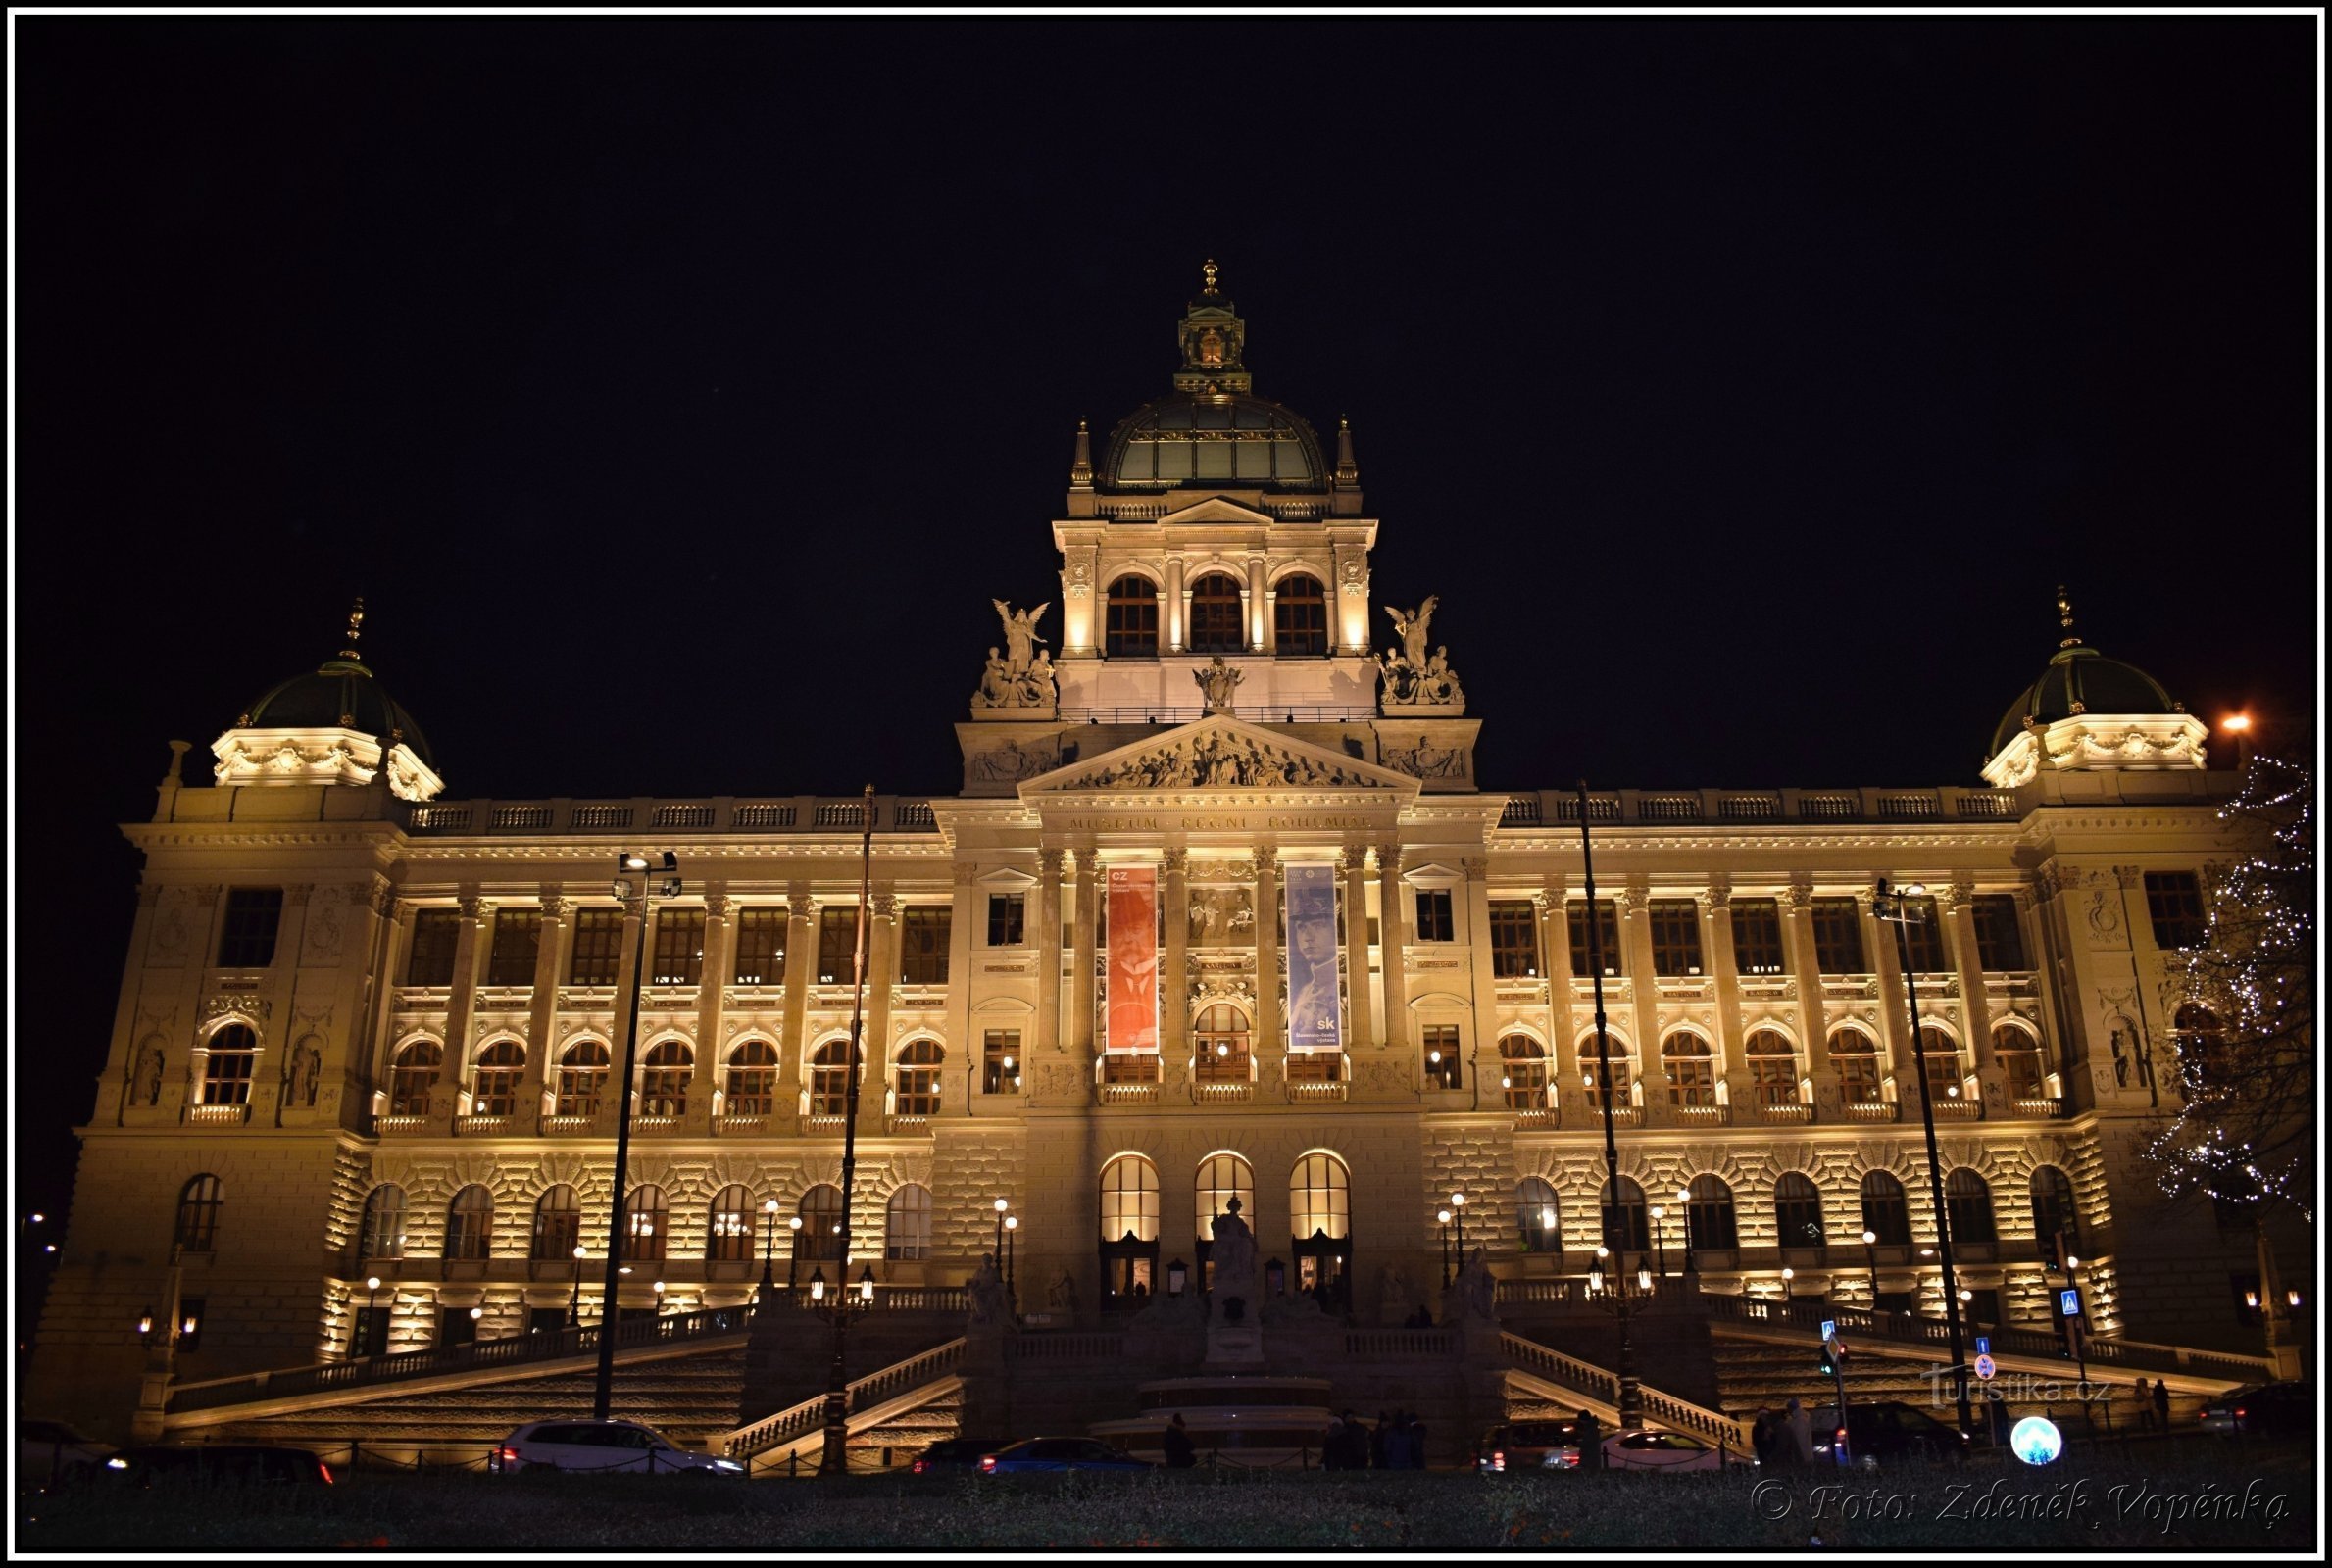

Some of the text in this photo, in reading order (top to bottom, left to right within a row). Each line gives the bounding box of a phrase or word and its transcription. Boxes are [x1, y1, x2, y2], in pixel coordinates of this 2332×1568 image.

[1068, 815, 1372, 830] MUSEUM REGNI BOHEMIAE
[1316, 1016, 1336, 1030] sk
